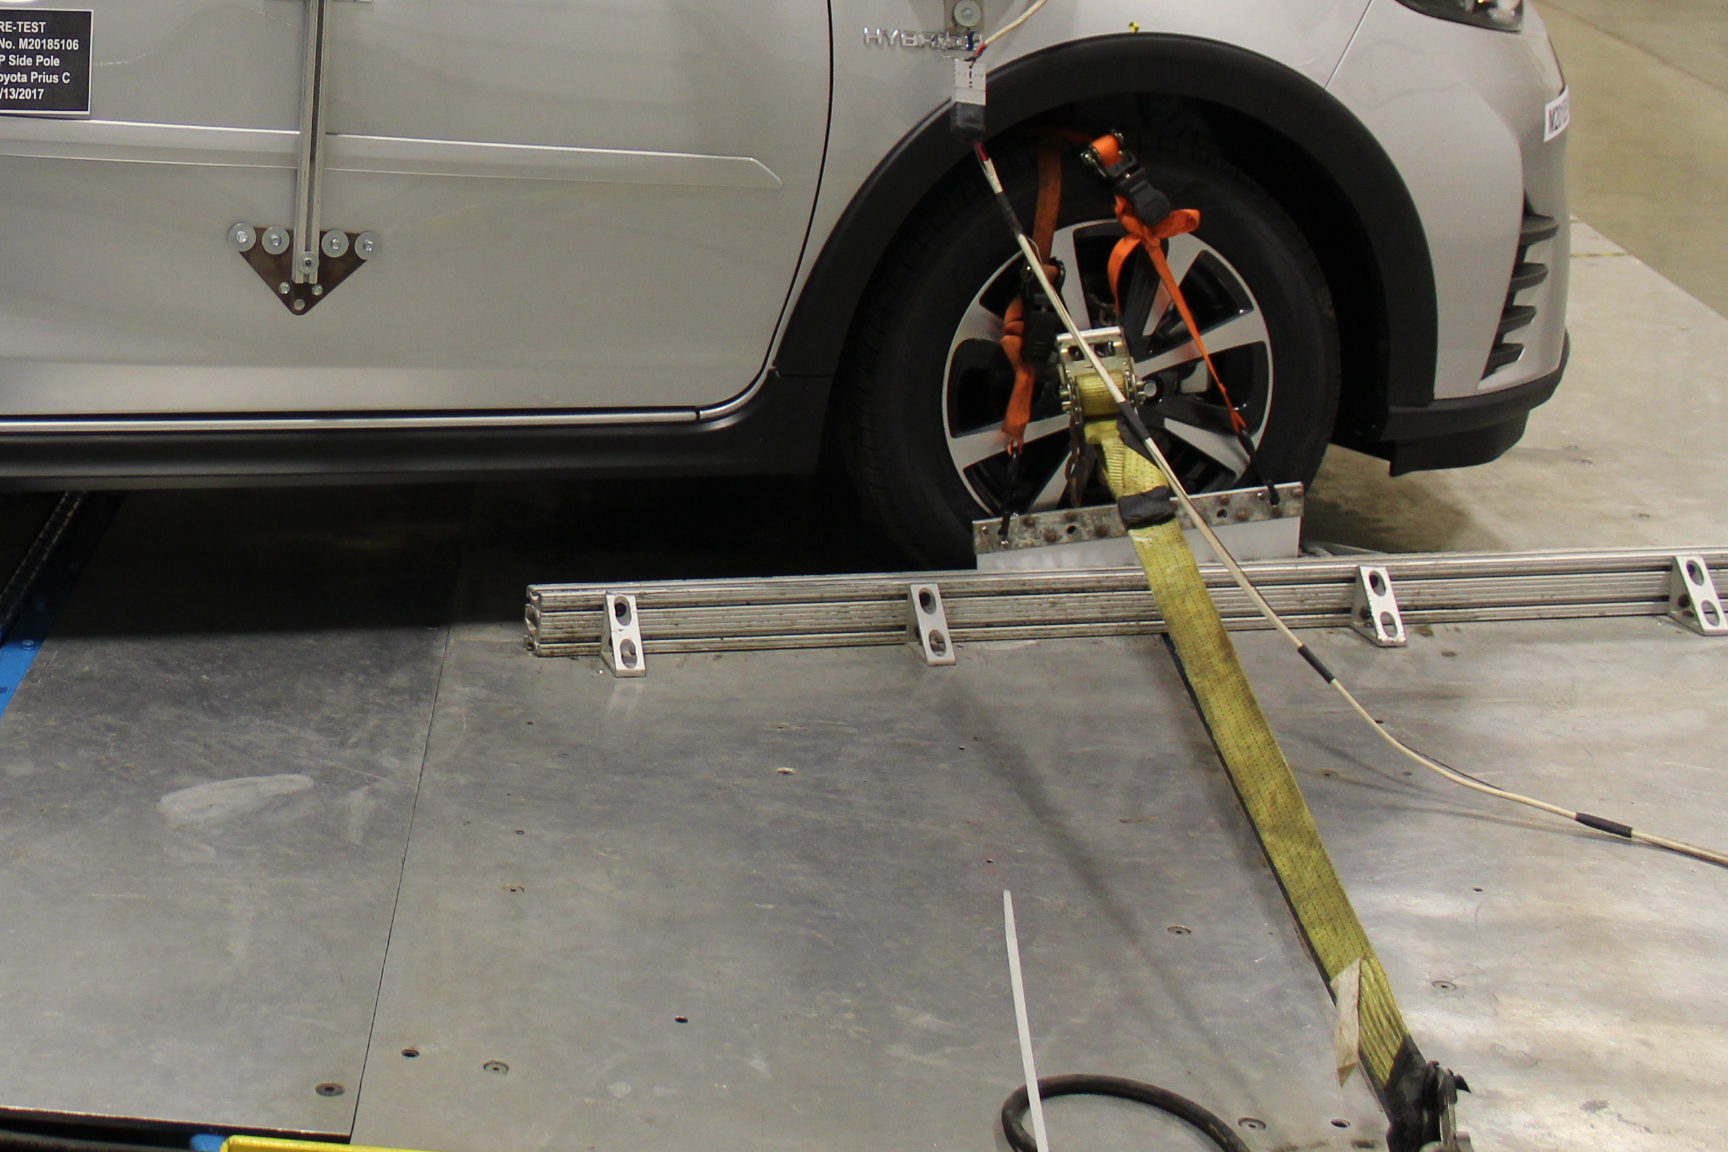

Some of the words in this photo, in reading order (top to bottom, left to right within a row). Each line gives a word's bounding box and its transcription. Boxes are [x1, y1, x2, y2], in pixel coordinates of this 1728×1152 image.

[18, 38, 80, 51] M20185106
[8, 55, 33, 67] Side
[35, 55, 61, 68] Pole
[30, 71, 59, 84] Prius
[61, 72, 71, 84] C
